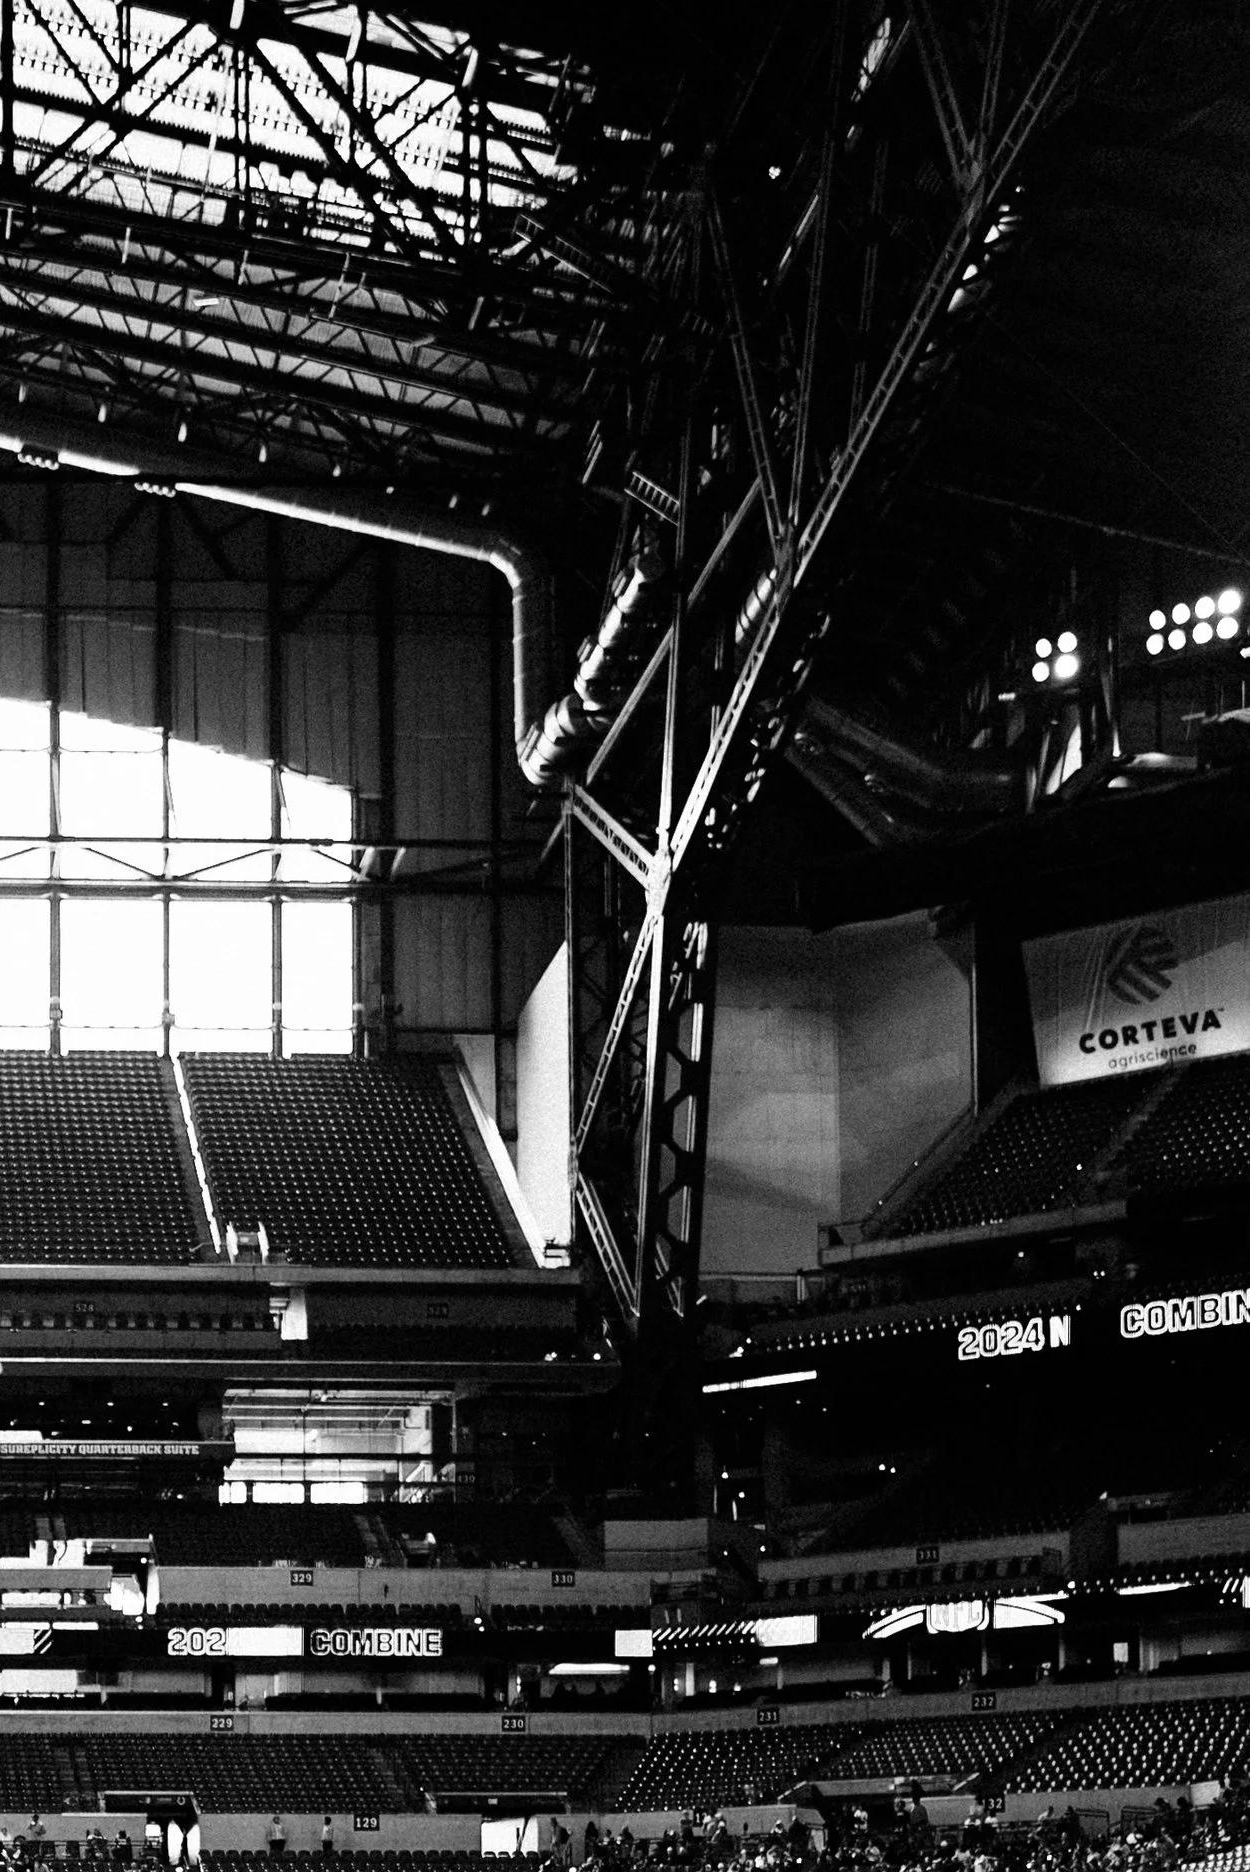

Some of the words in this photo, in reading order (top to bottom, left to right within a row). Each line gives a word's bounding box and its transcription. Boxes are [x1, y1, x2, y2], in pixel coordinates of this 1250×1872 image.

[1079, 1010, 1222, 1053] CORTEVA
[1108, 1043, 1197, 1070] agriscience
[958, 1317, 1046, 1360] 2024
[78, 1444, 163, 1456] QUARTERBACK
[164, 1444, 200, 1456] SUITE
[291, 1573, 312, 1584] 329
[310, 1628, 443, 1656] COMBINE
[211, 1718, 233, 1729] 229
[503, 1719, 524, 1730] 230
[356, 1817, 377, 1828] 129
